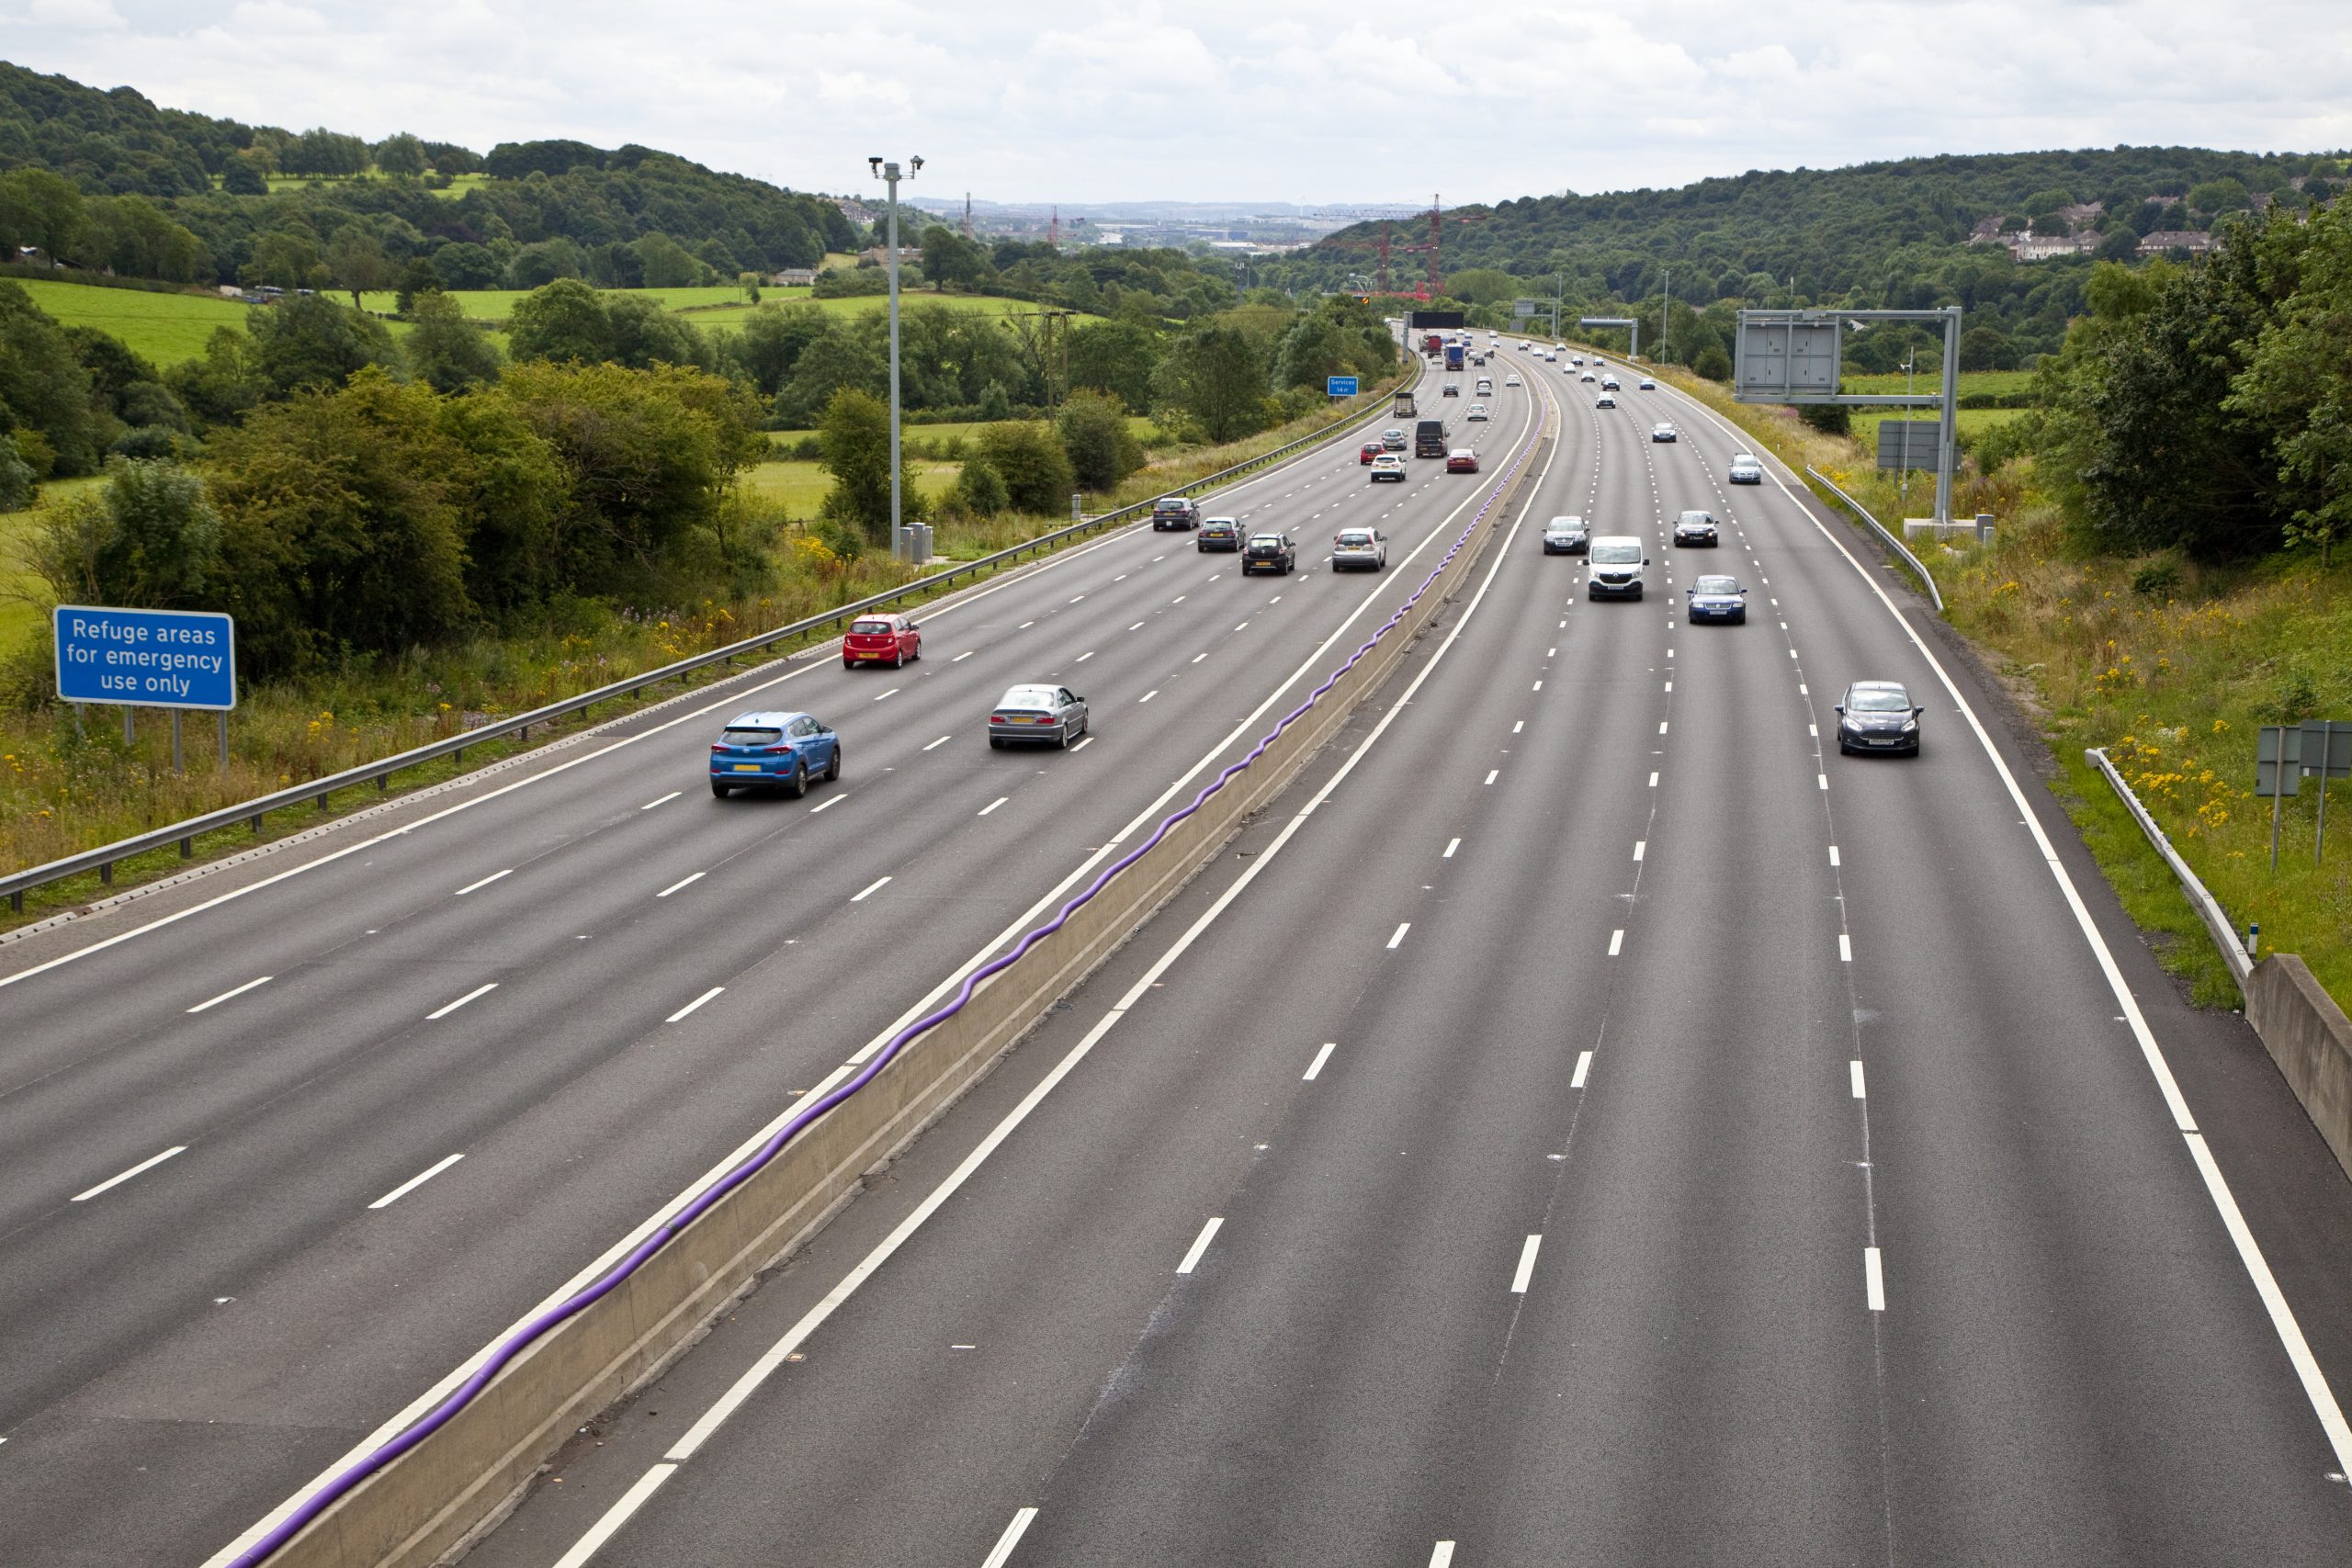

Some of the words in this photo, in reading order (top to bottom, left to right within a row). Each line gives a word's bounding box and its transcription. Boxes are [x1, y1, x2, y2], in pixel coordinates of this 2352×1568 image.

[73, 619, 149, 645] Refuge
[156, 627, 216, 645] areas
[66, 644, 98, 663] for
[106, 649, 222, 673] emergency
[101, 674, 138, 690] use
[145, 673, 190, 697] only
